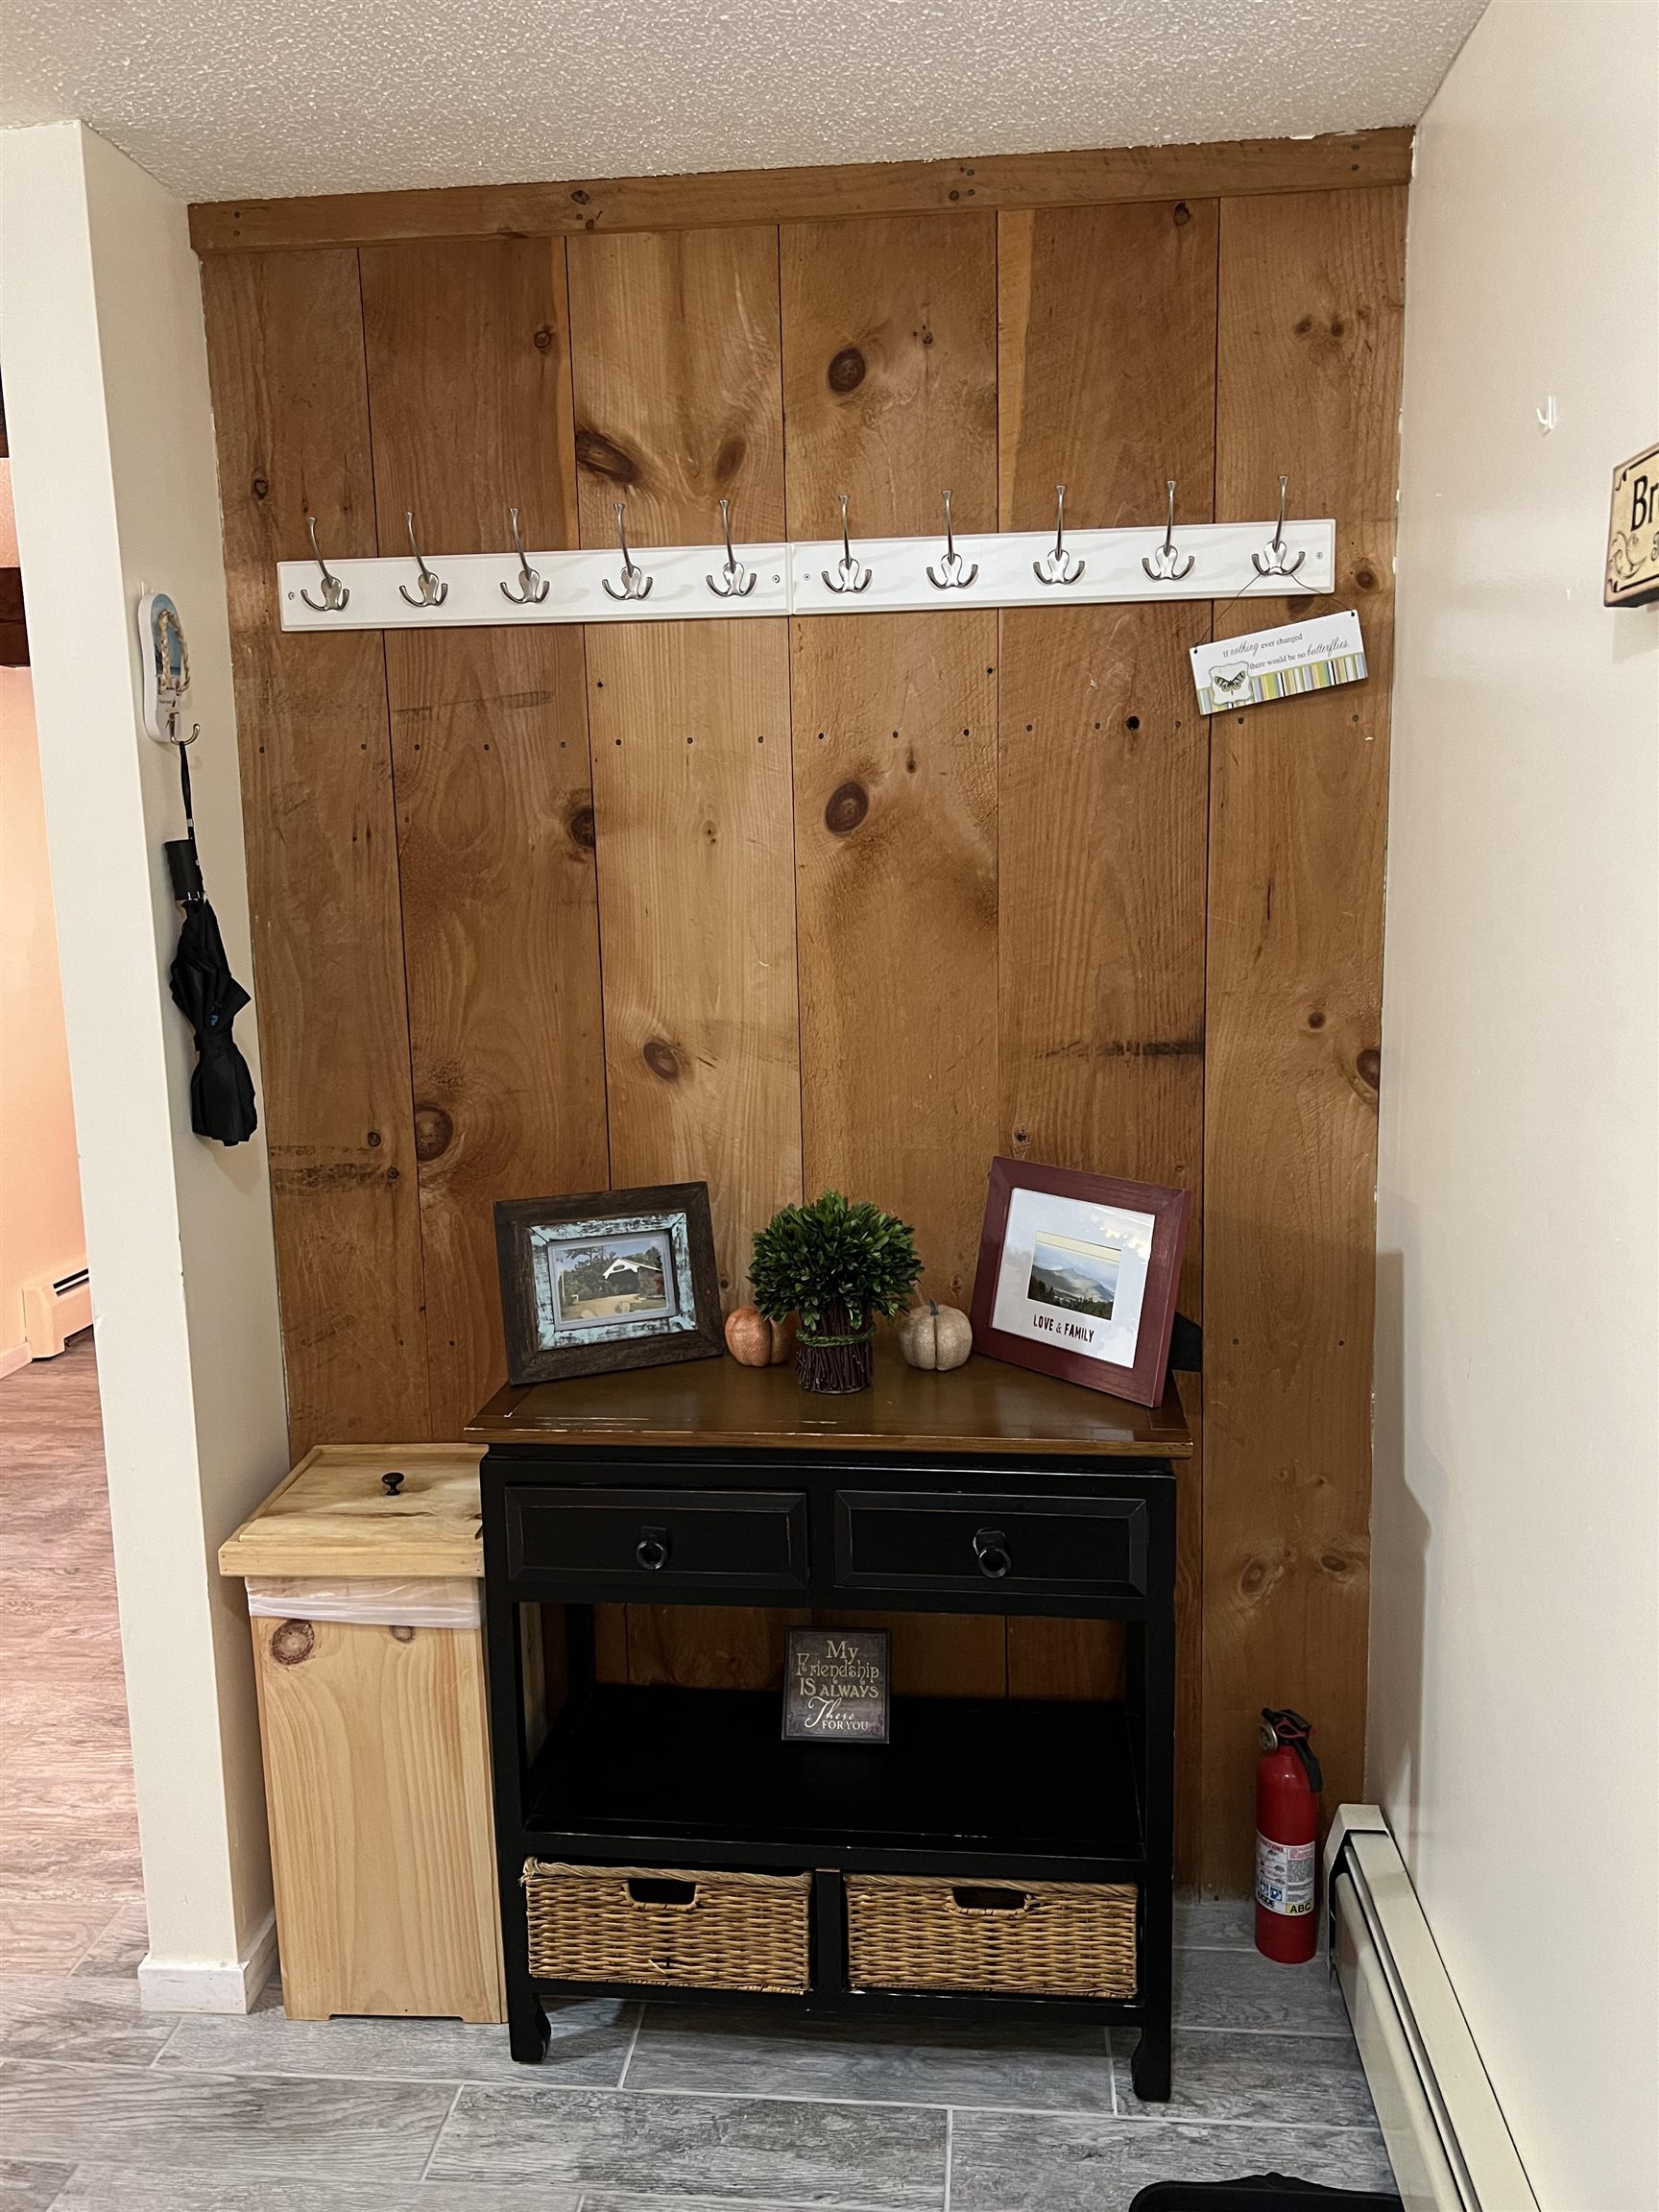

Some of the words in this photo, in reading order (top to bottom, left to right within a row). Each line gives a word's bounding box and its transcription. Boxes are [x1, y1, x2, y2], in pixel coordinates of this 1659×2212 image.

[1230, 640, 1259, 657] nothing
[1261, 640, 1275, 649] ever
[1276, 634, 1303, 646] changed
[1249, 661, 1265, 670] there
[1267, 655, 1286, 666] would
[1287, 653, 1296, 661] be
[1033, 1314, 1054, 1332] LOVE
[1056, 1323, 1062, 1334] &
[1064, 1322, 1094, 1343] FAMILY
[826, 1640, 859, 1665] My
[795, 1652, 879, 1685] Friendship
[800, 1677, 817, 1696] IS
[819, 1684, 879, 1698] ALWAYS
[805, 1695, 854, 1728] There
[822, 1719, 844, 1730] FOR
[845, 1720, 869, 1730] YOU
[1289, 1902, 1311, 1913] ABC
